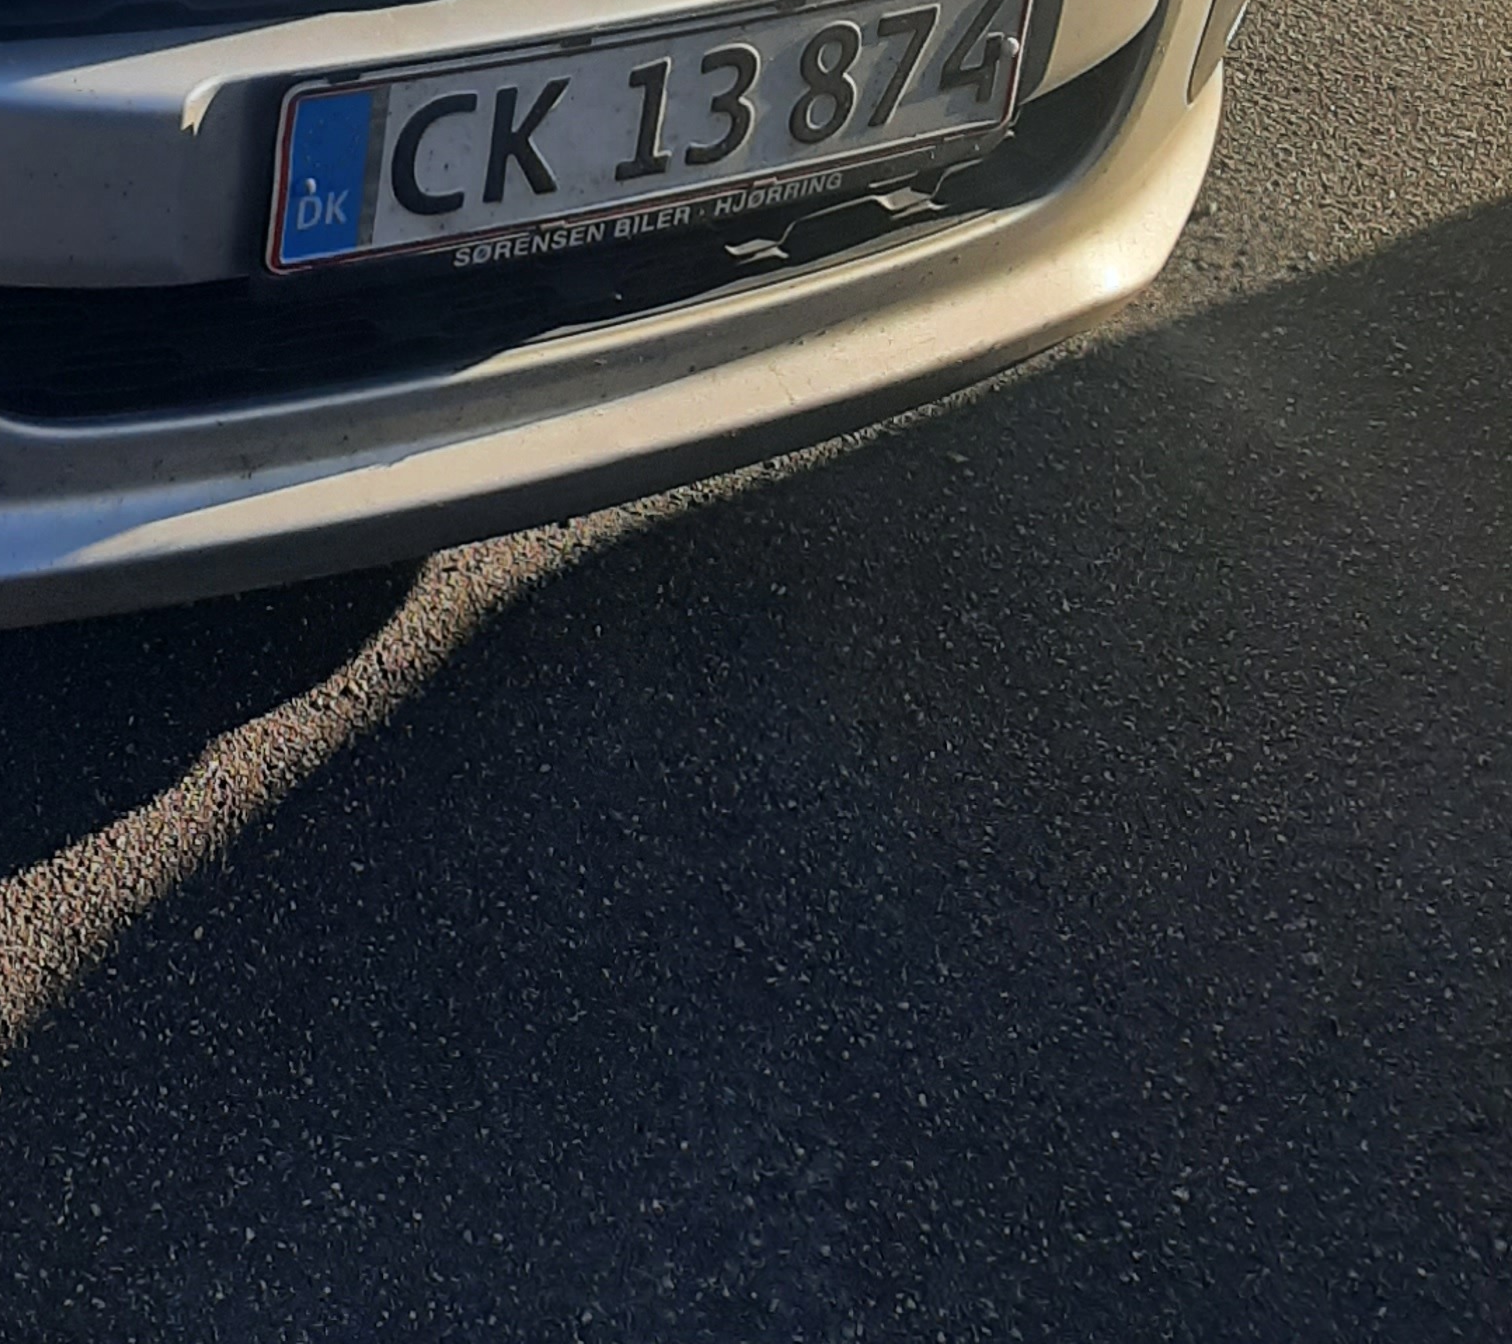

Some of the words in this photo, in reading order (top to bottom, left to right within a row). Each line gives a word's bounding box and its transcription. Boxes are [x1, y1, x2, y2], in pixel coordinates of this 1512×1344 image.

[391, 77, 571, 216] CK
[615, 43, 762, 181] 13
[296, 189, 347, 230] DK
[453, 223, 606, 268] SØRENSEN
[614, 205, 691, 238] BILER
[714, 172, 843, 217] HJØRRING
